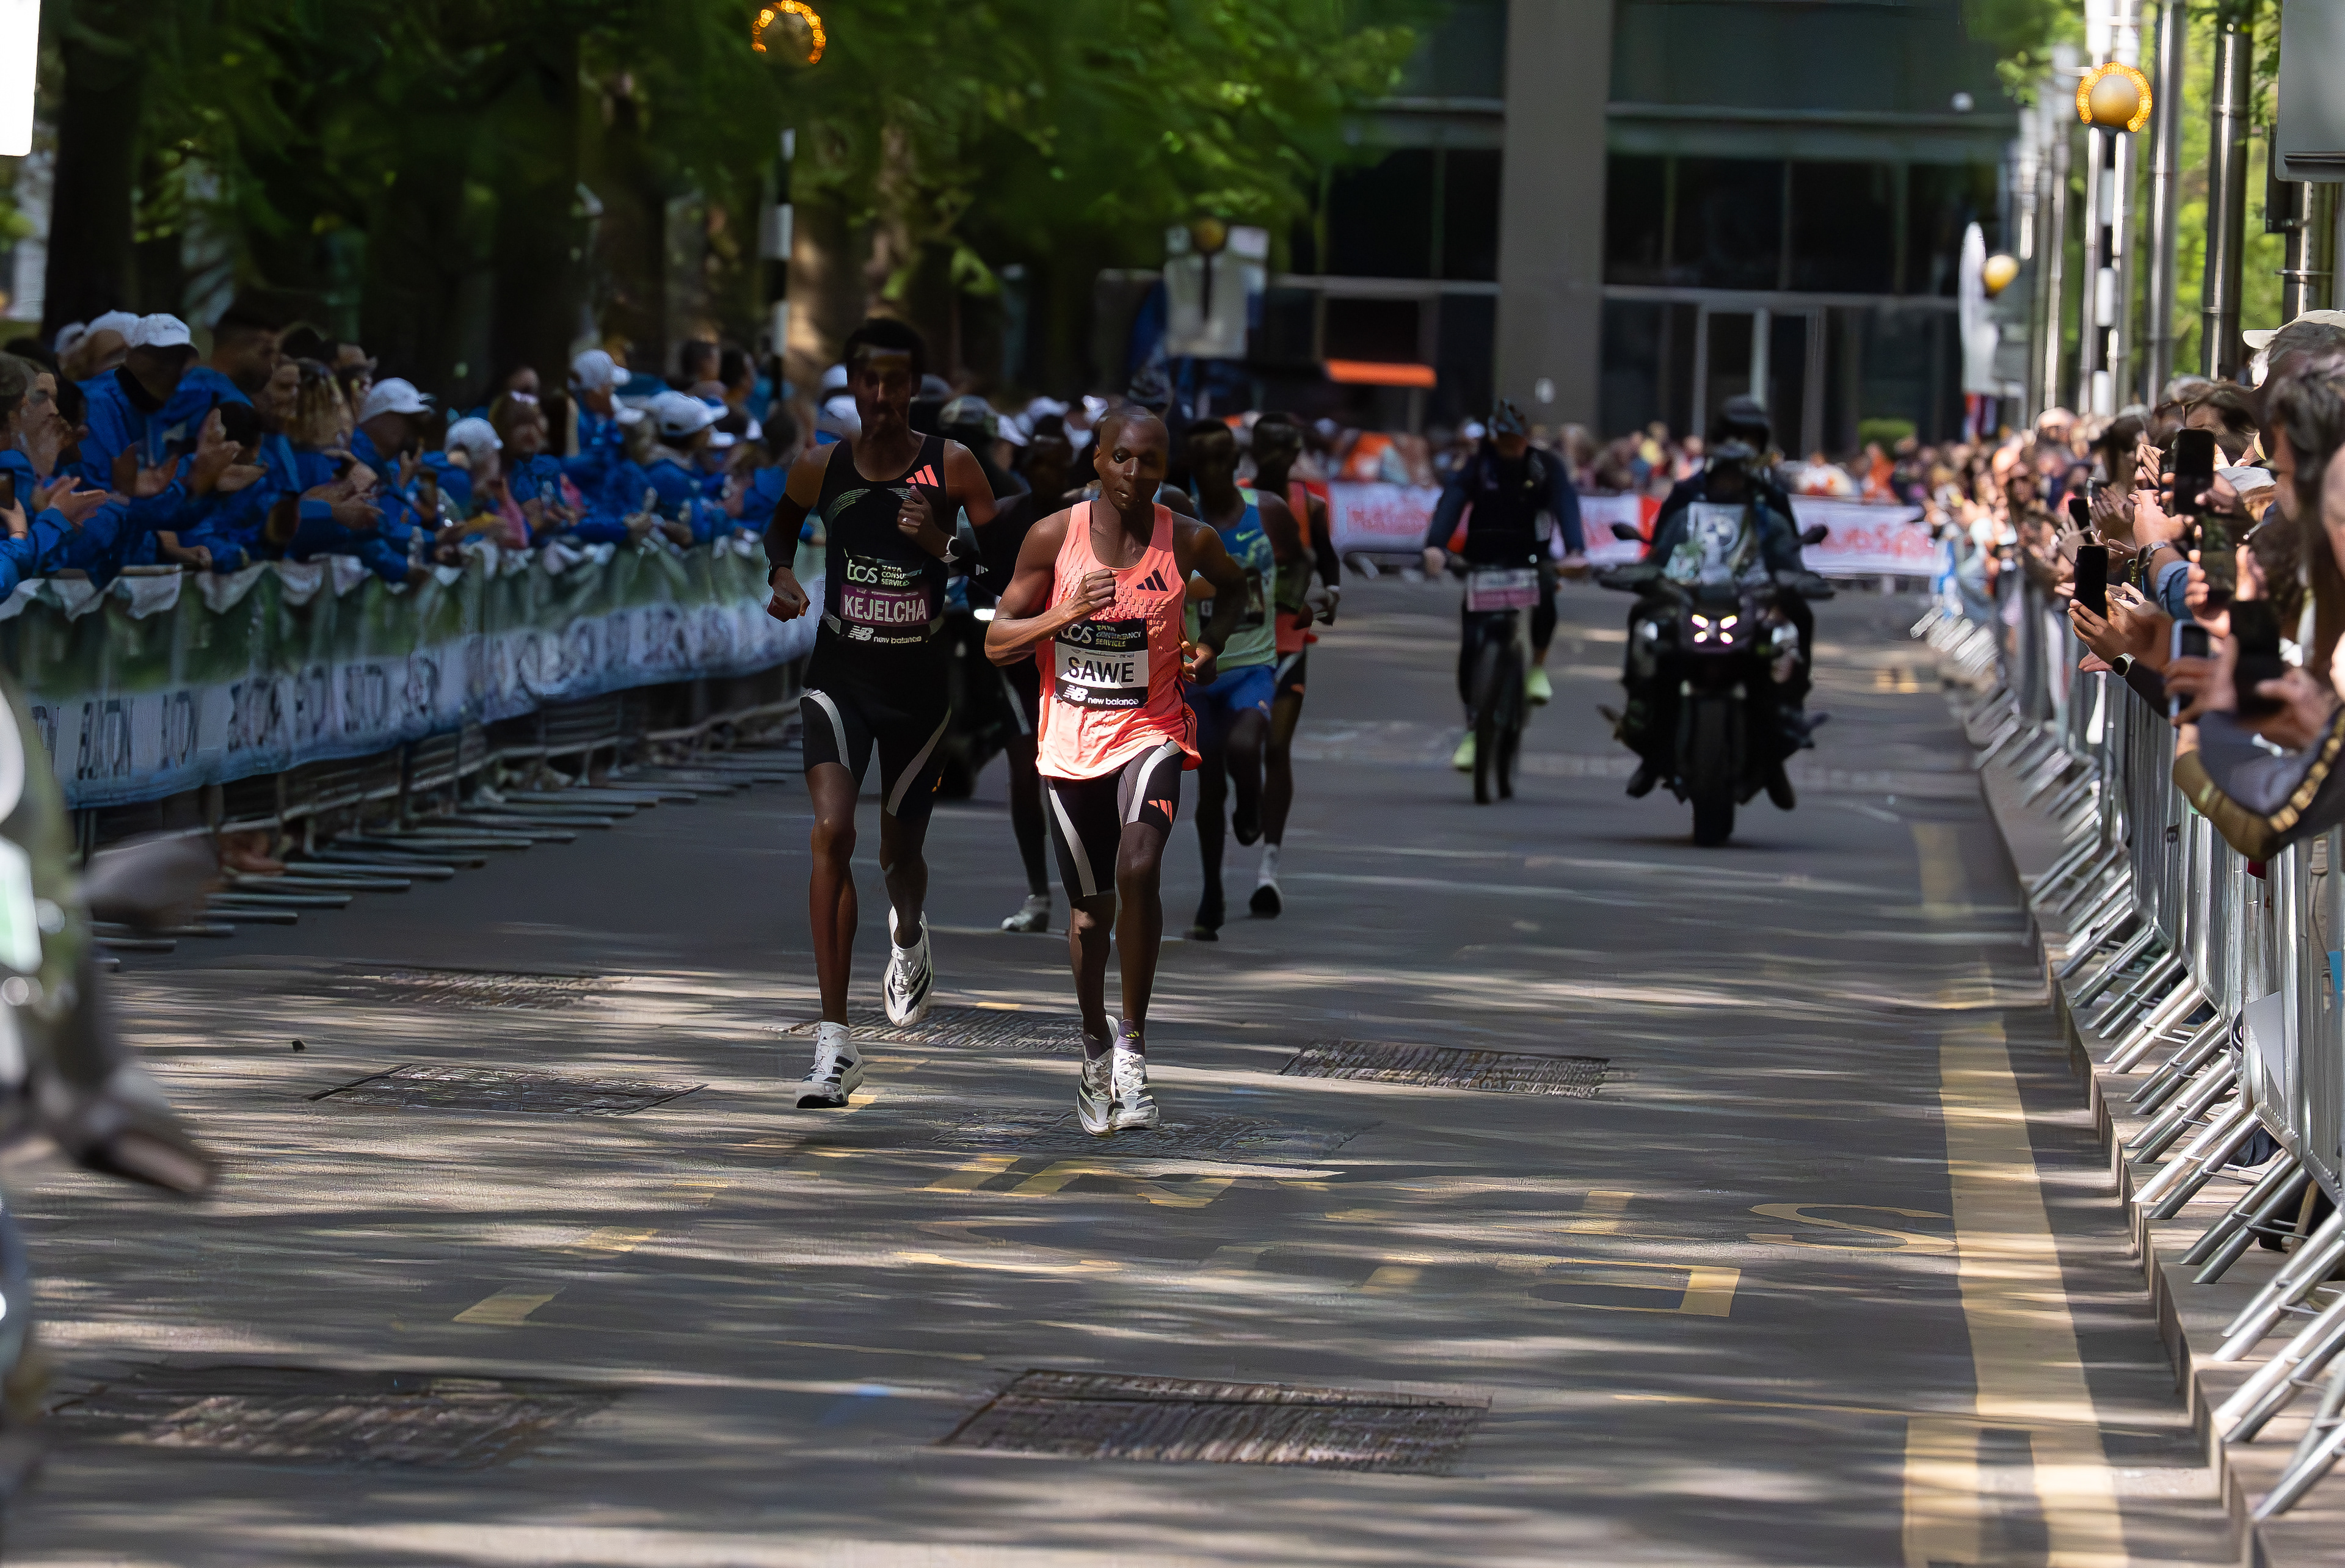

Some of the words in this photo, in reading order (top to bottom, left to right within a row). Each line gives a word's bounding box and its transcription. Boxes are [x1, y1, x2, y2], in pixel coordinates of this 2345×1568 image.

[847, 559, 878, 584] tcs
[844, 594, 926, 623] KEJELCHA
[1068, 656, 1135, 683] SAWE
